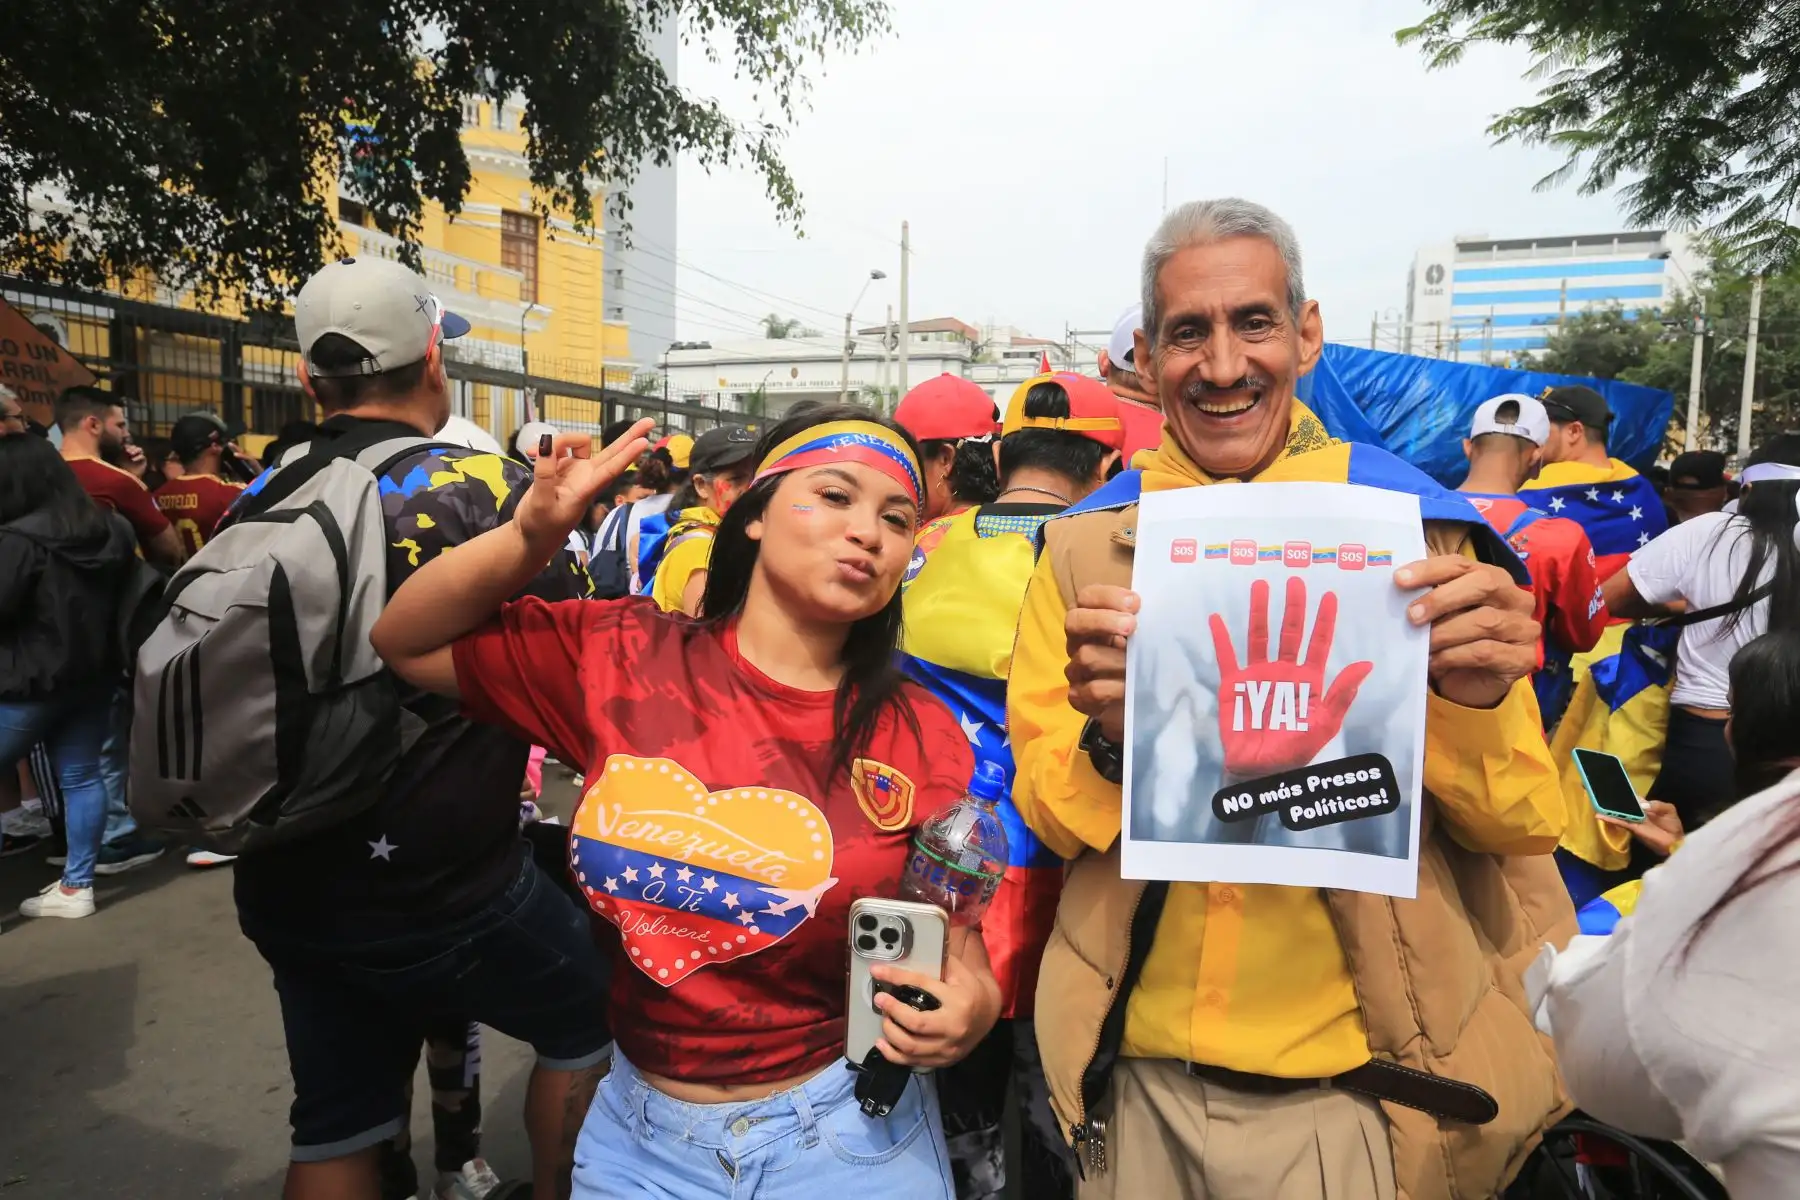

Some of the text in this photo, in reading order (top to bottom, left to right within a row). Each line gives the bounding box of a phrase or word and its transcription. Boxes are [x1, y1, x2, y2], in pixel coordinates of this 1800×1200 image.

[25, 341, 59, 363] UN
[0, 360, 58, 386] RRIL
[1173, 546, 1363, 563] SOS SOS SOS SOS
[1232, 680, 1311, 732] ¡YA!
[1222, 767, 1382, 815] NO más Presos
[1289, 787, 1390, 823] Políticos!
[597, 803, 806, 883] Venezuela
[912, 855, 977, 897] CIELO
[677, 885, 706, 912] Ti
[619, 910, 711, 944] Volveré
